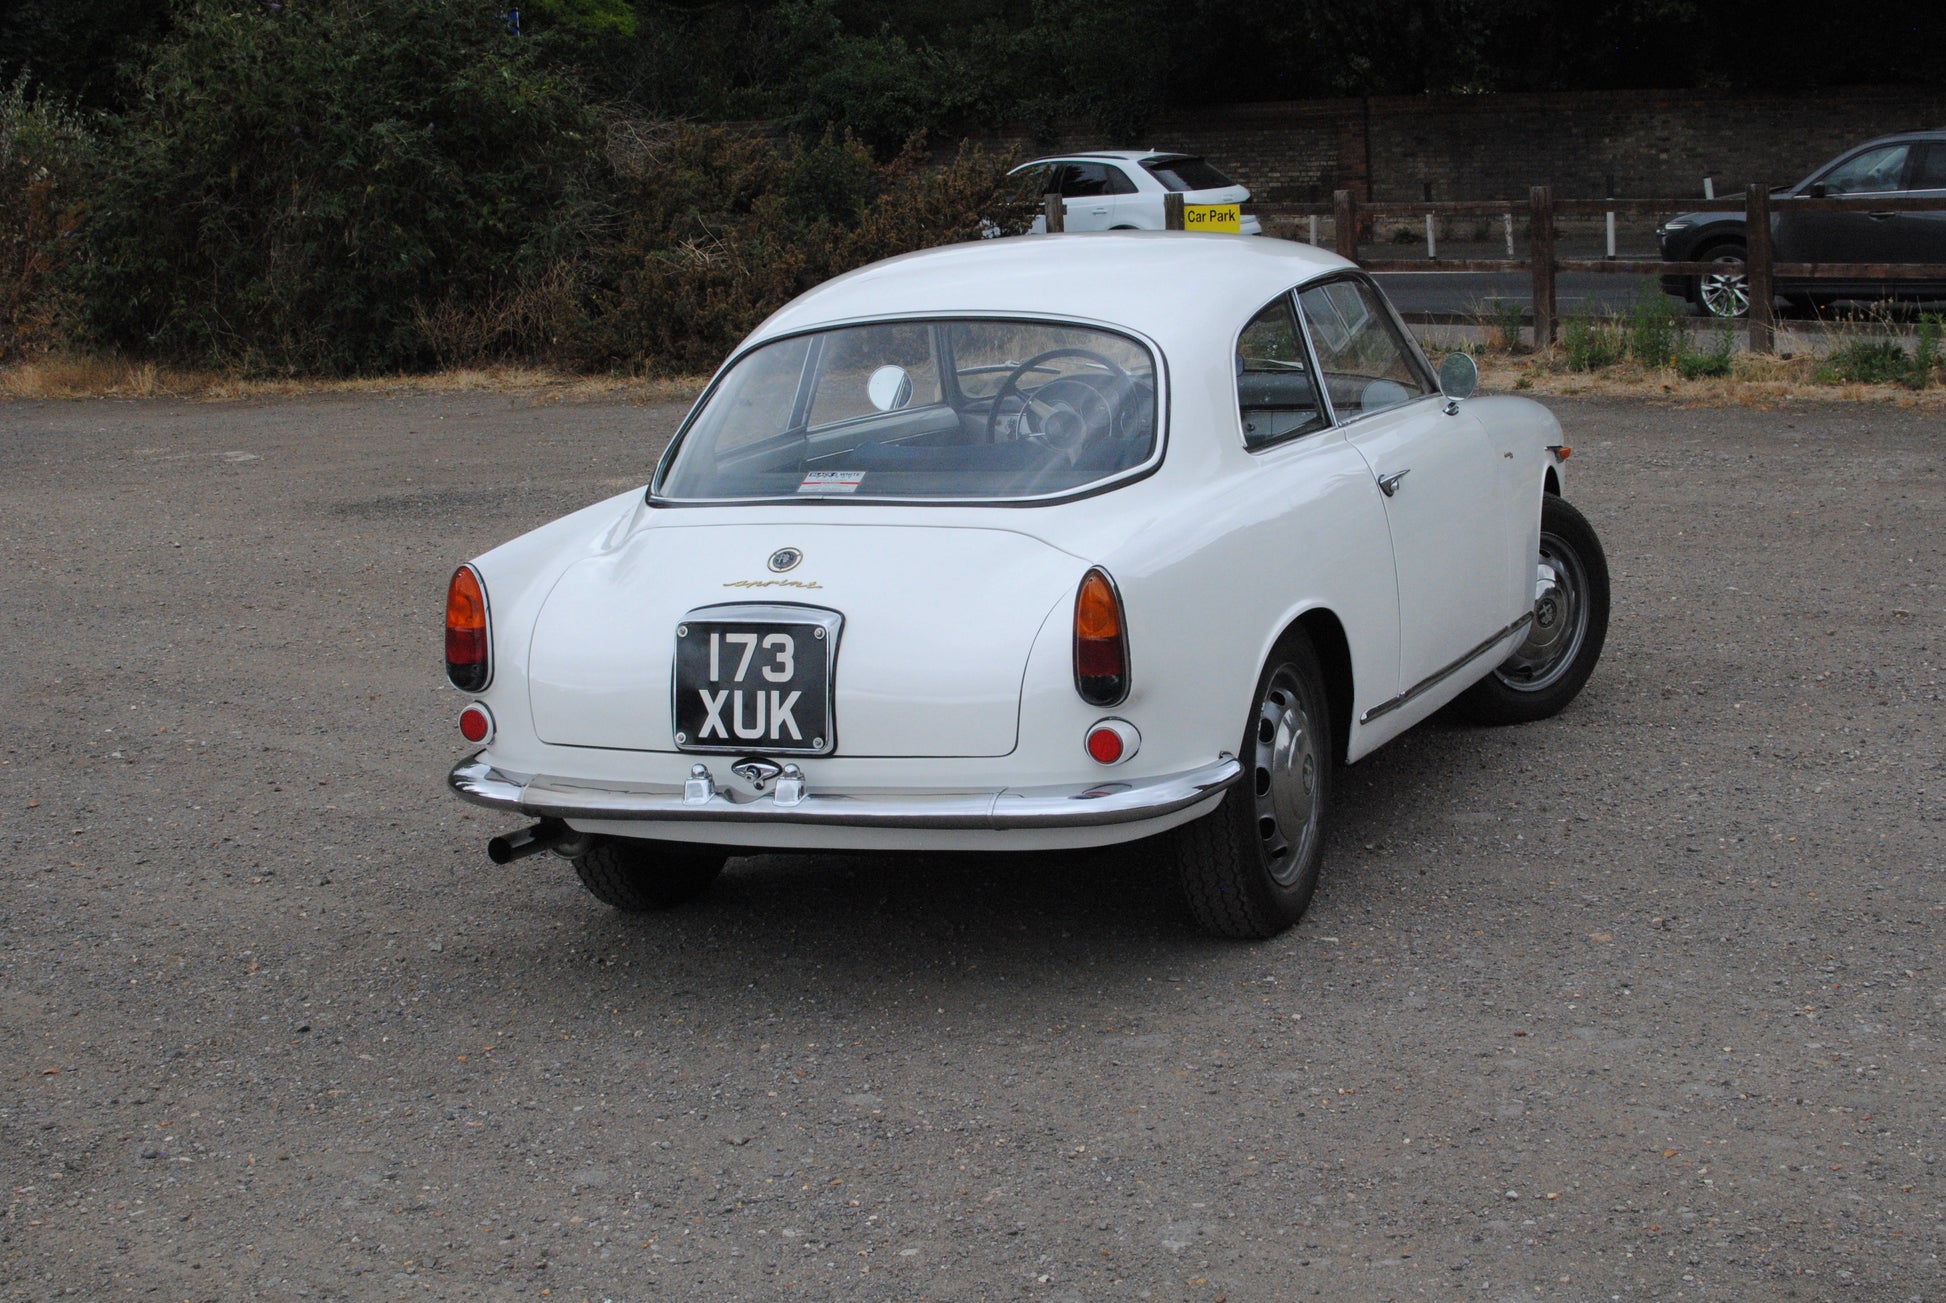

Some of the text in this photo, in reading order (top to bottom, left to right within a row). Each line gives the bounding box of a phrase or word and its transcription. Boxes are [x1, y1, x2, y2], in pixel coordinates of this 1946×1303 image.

[1187, 209, 1236, 223] Car Park
[709, 633, 795, 683] 173
[698, 689, 803, 740] XUK
